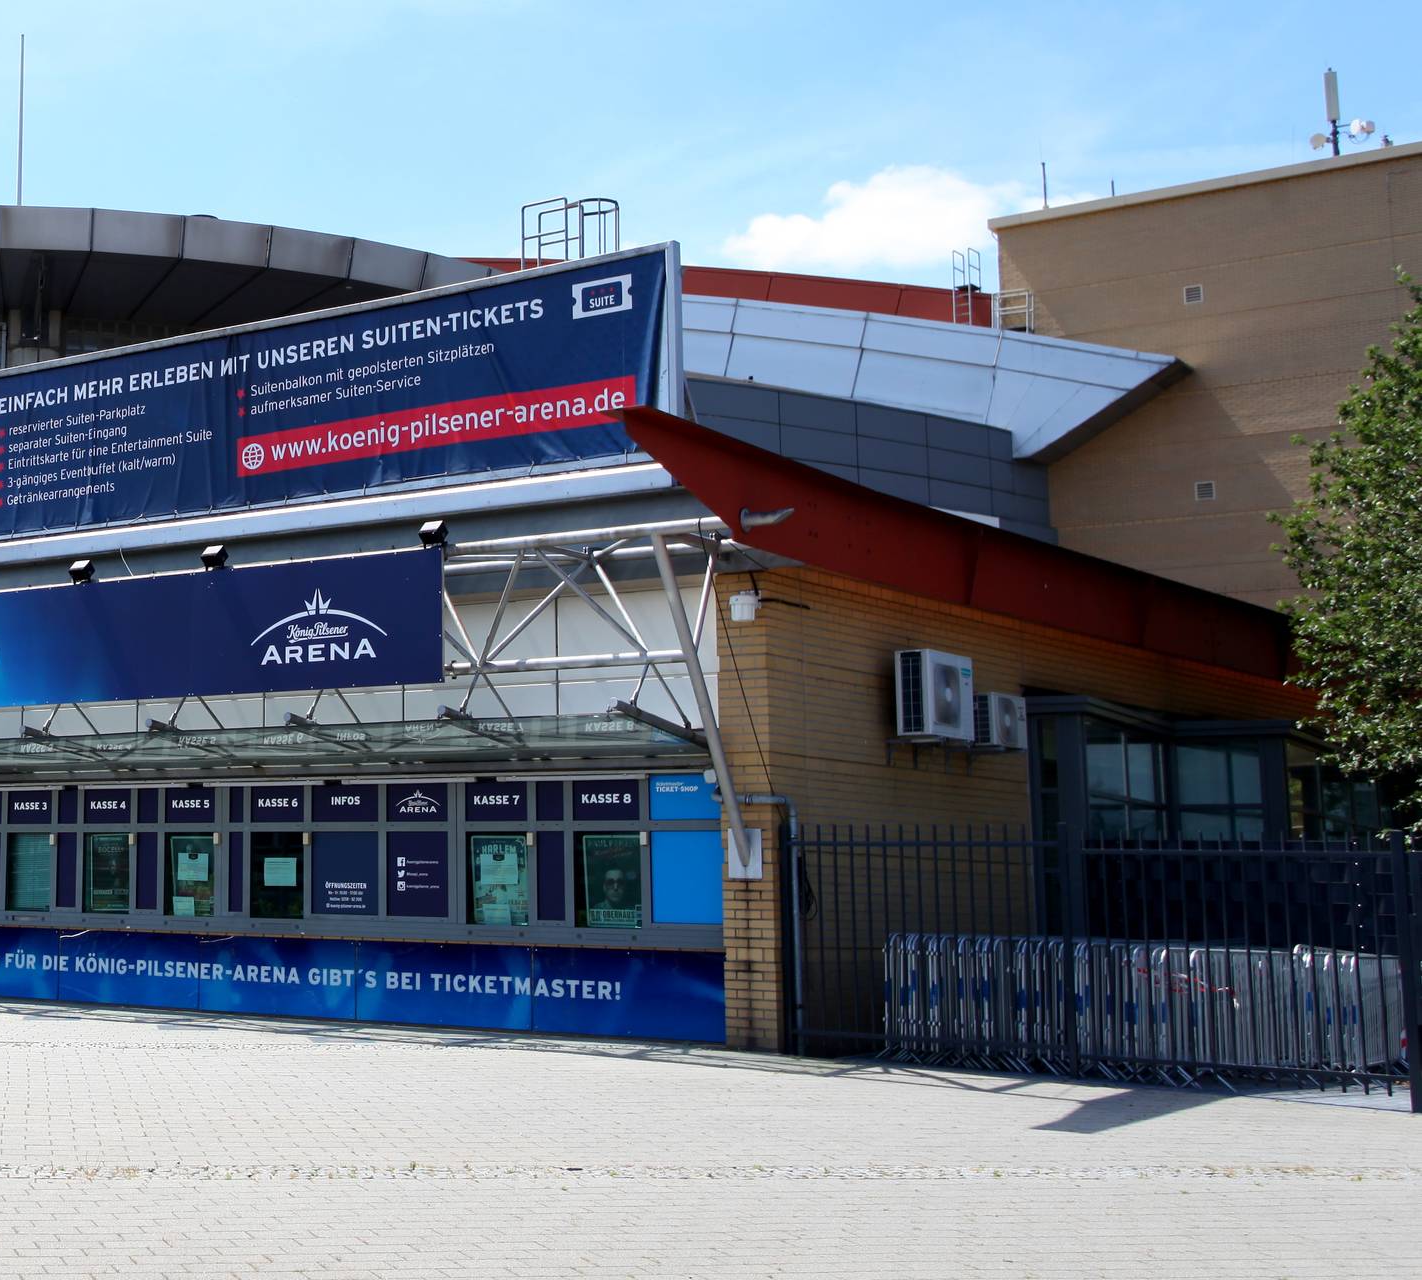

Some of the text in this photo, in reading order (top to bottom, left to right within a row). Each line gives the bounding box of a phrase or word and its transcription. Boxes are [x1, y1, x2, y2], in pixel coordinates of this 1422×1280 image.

[589, 294, 615, 309] SUITE
[74, 377, 123, 401] MEHR
[129, 364, 213, 393] ERLEBEN
[220, 354, 251, 377] MIT
[257, 334, 354, 370] UNSEREN
[362, 298, 544, 349] SUITEN-TICKETS
[250, 341, 495, 397] Suitenbalkon mit gepolsterten Sitzplätzen
[250, 373, 422, 416] aufmerksamer Suiten-Service
[8, 403, 146, 436] reservierter Suiten-Parkplatz
[271, 387, 626, 461] www.koenig-pilsener-arena.de
[7, 428, 213, 471] Eintrittskarte für eine Entertainment Suite
[8, 425, 127, 456] separater Suiten-Eingang
[6, 452, 176, 491] 3-gängiges Eventbuffet (kalt/warm)
[6, 480, 115, 507] Getränkearrangements
[287, 621, 348, 640] König Pilsener
[260, 638, 376, 665] ARENA
[14, 801, 48, 811] KASSE 3
[90, 800, 126, 810] KASSE 4
[172, 799, 210, 809] KASSE 5
[258, 798, 298, 808] KASSE 6
[331, 796, 360, 805] INFOS
[473, 795, 520, 805] KASSE 7
[581, 793, 631, 804] KASSE 8
[4, 948, 37, 971] FÜR
[42, 954, 68, 972] DIE
[75, 952, 299, 984] KÖNIG-PILSENER-ARENA
[386, 970, 421, 991] BEI
[430, 973, 621, 1001] TICKETMASTER!
